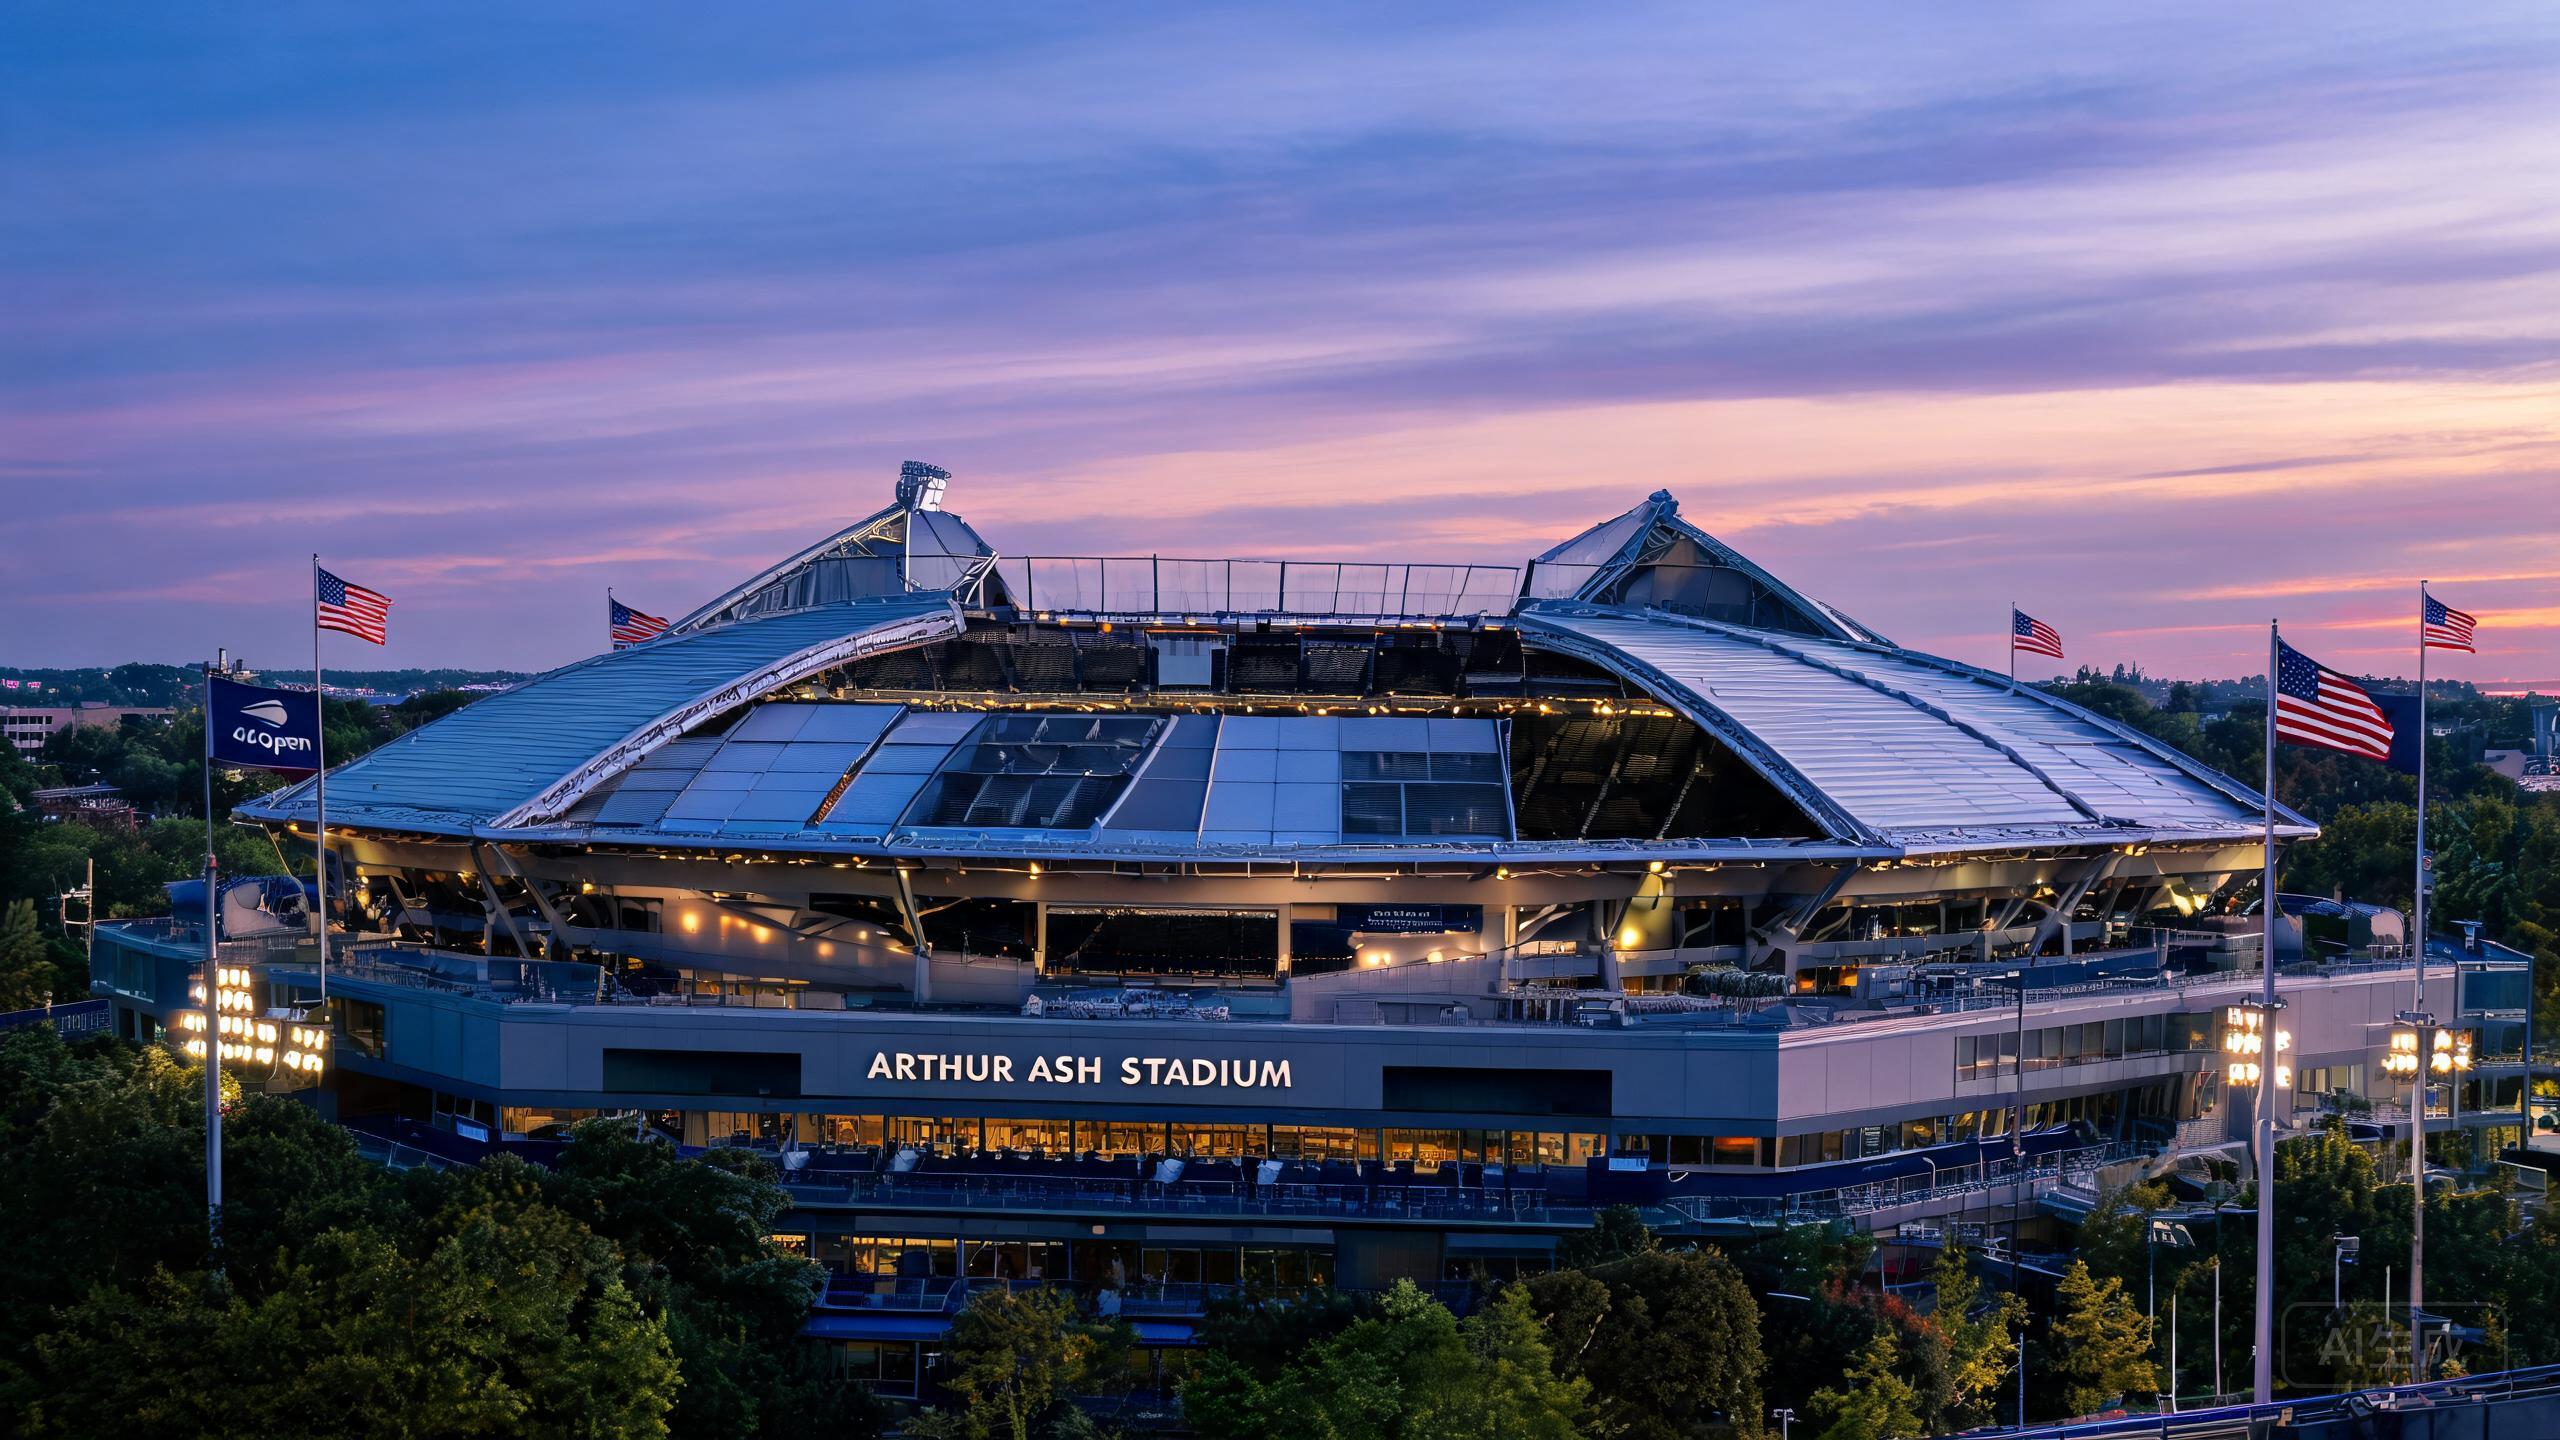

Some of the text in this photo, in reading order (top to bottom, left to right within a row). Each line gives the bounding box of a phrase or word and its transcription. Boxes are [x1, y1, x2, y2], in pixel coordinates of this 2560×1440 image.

[867, 1051, 1292, 1088] ARTHUR ASH STADIUM
